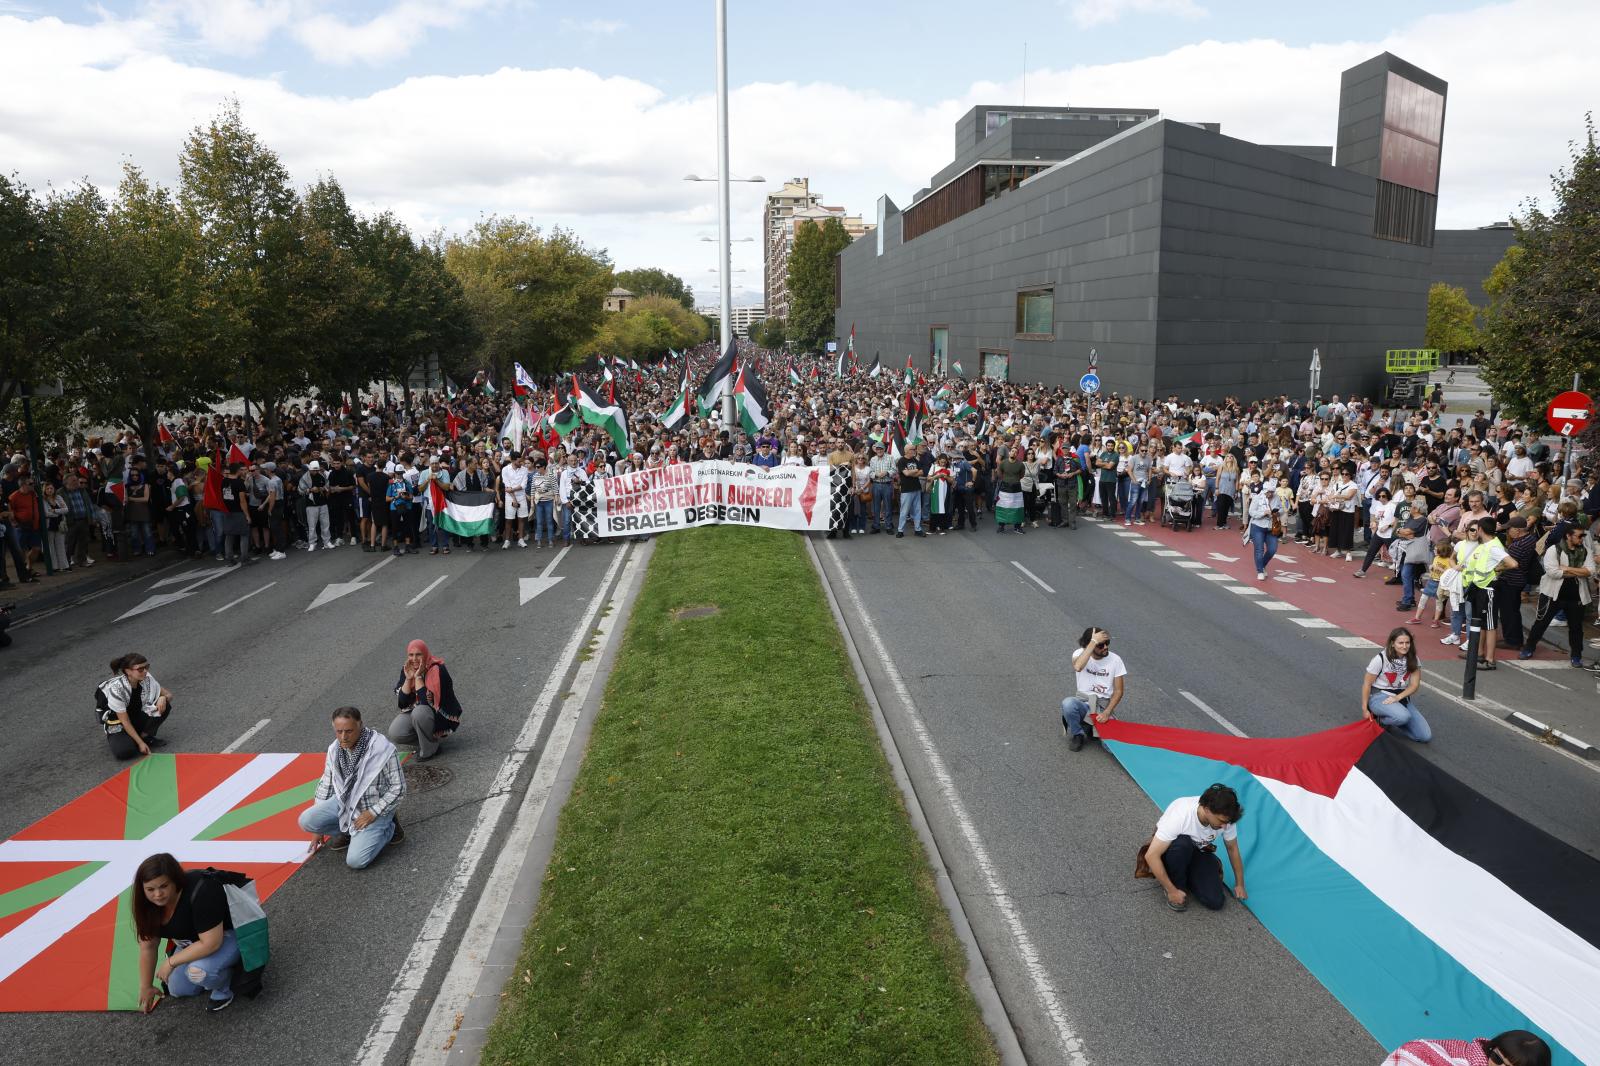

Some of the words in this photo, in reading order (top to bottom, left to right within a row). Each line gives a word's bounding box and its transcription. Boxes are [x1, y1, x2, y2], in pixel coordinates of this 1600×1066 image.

[604, 464, 693, 497] PALESTINAR
[606, 483, 723, 516] ERRESISTENTZIA
[727, 484, 793, 508] AURRERA
[607, 511, 678, 532] ISRAEL
[684, 504, 760, 524] DESEGIN
